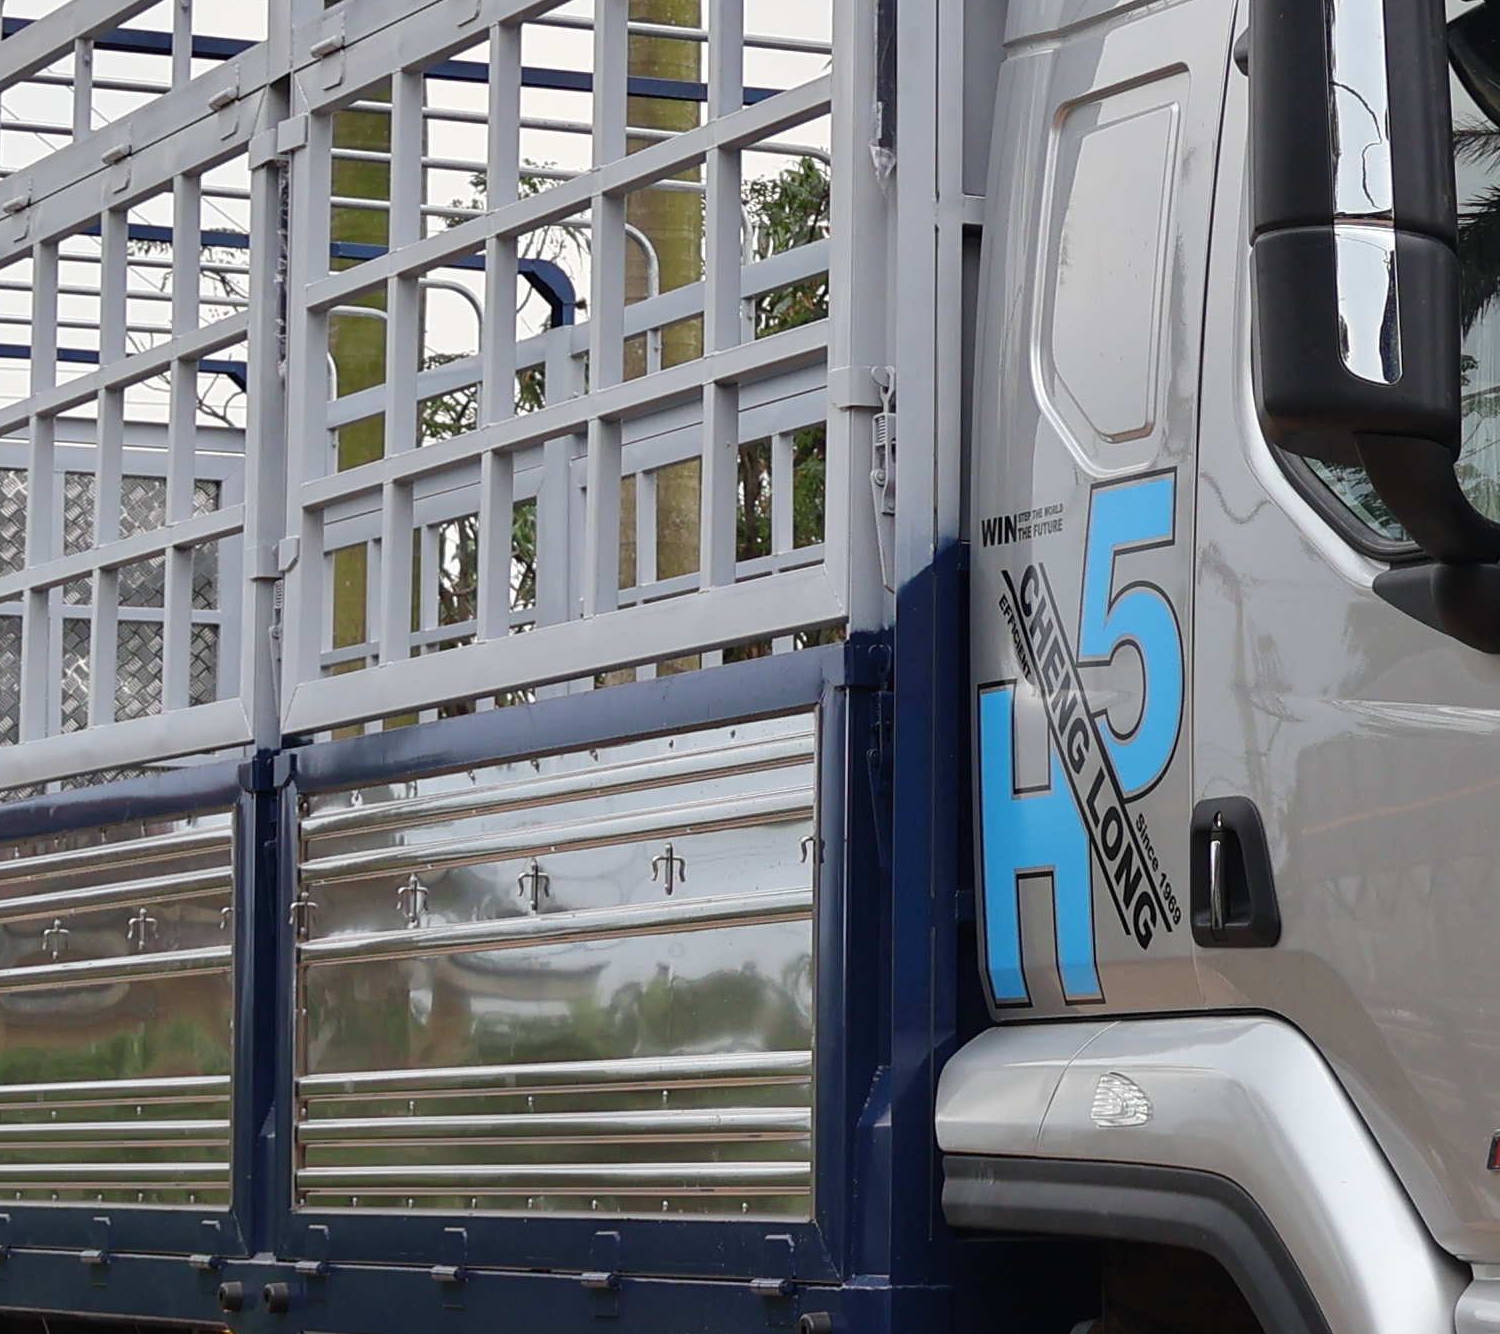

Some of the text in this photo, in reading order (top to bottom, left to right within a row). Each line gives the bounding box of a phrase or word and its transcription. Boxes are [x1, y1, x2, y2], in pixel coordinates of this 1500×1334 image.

[981, 514, 1064, 548] WIN THE FUTURE
[1032, 507, 1043, 520] THE
[1044, 503, 1064, 517] WORLD
[998, 593, 1032, 680] EFFICIENT
[1019, 564, 1158, 951] CHENG LONG
[1136, 812, 1182, 925] Since 1969
